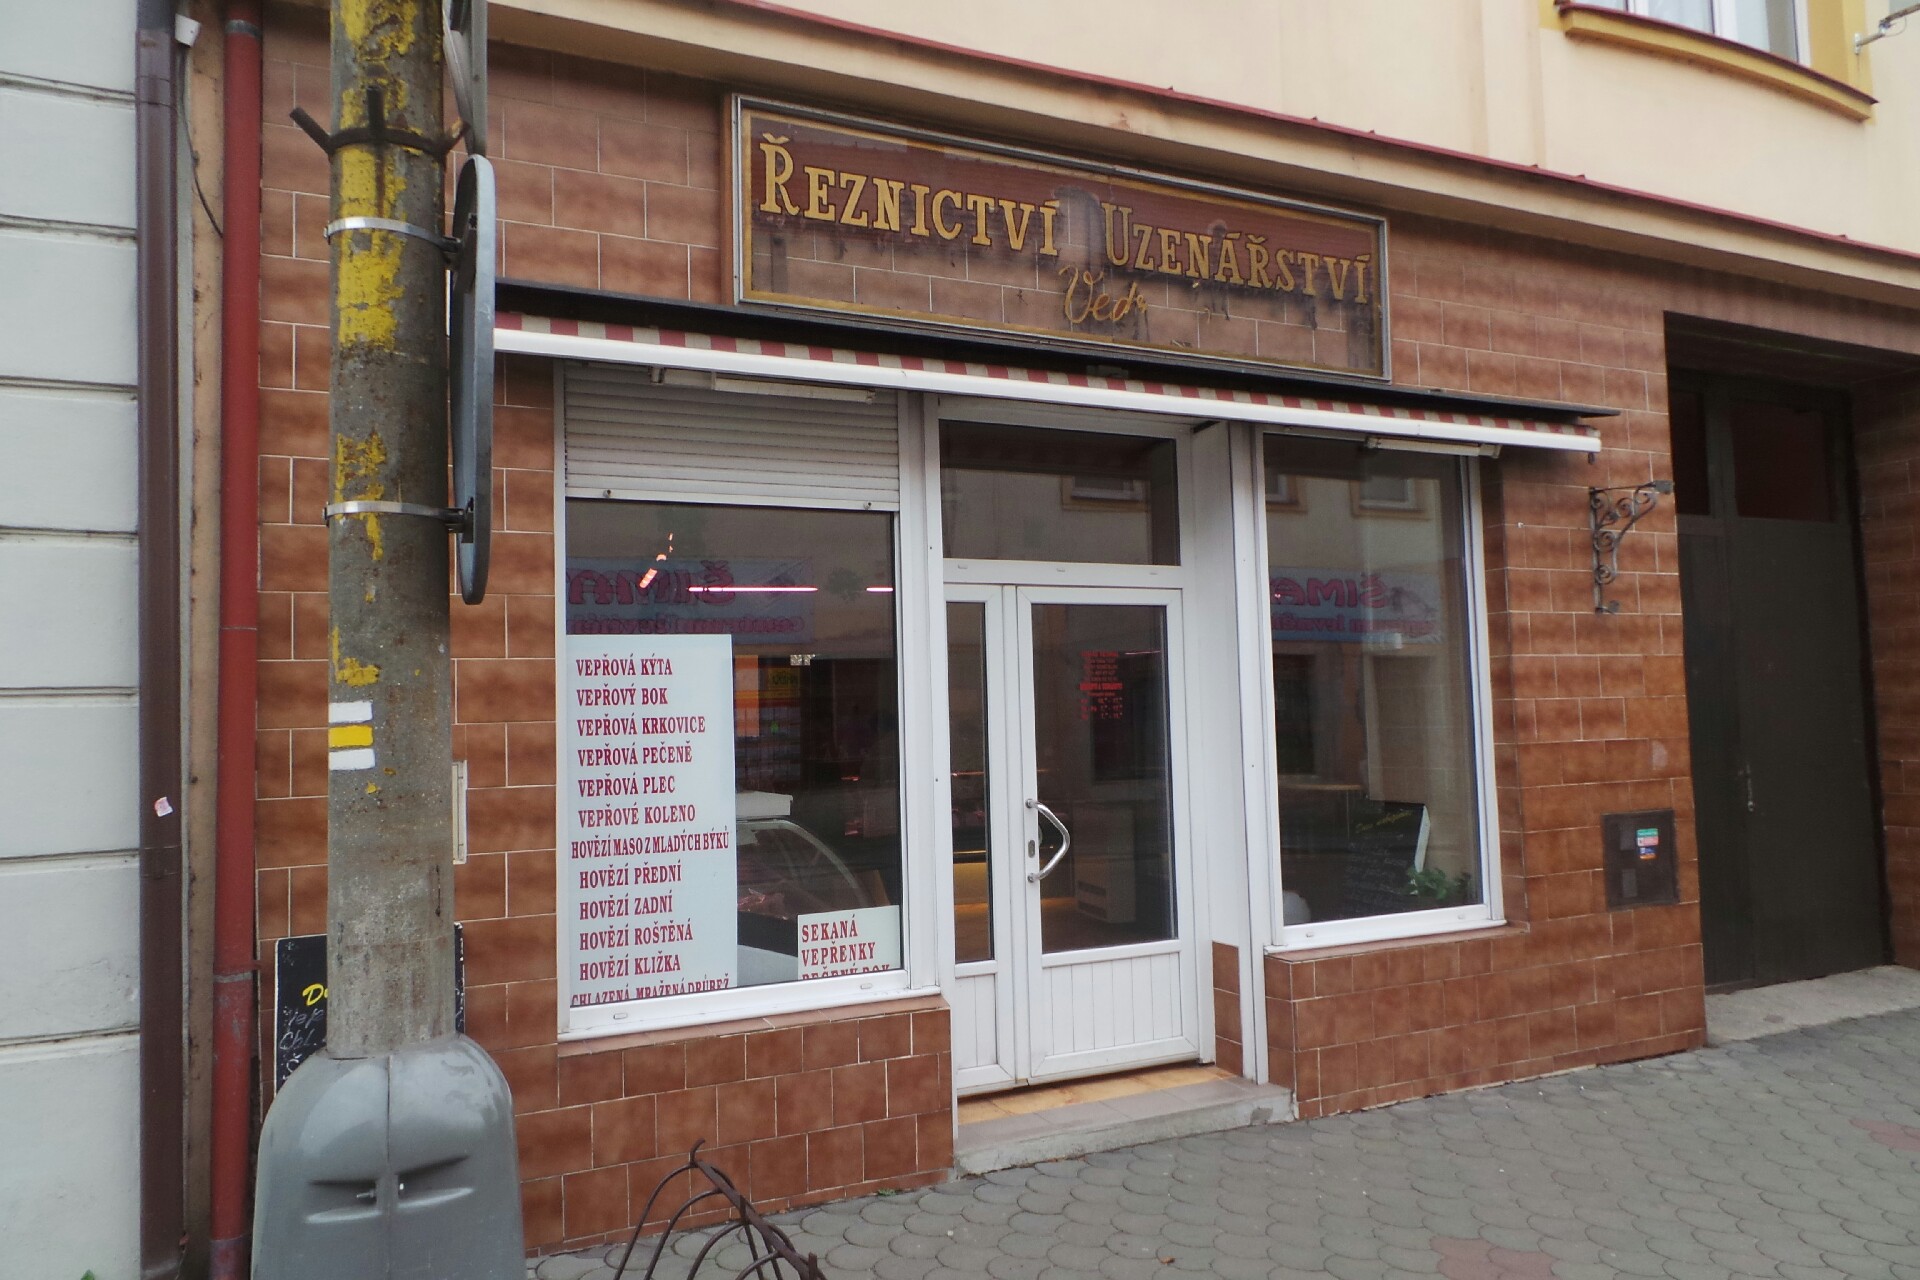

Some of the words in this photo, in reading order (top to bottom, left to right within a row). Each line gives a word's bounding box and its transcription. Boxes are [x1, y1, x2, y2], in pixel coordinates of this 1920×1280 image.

[760, 132, 1060, 256] ŘEZNICTVÍ
[1102, 202, 1370, 303] UZENÁŘSTVÍ
[576, 654, 636, 676] VEPŘOVÁ
[641, 653, 673, 676] KÝTA
[577, 684, 636, 706] VEPŘOVÝ
[641, 687, 668, 705] BOK
[577, 713, 637, 737] VEPŘOVÁ
[642, 716, 705, 735] KRKOVICE
[578, 743, 638, 767] VEPŘOVÁ
[642, 741, 692, 765] PEČENĚ
[578, 773, 638, 797] VEPŘOVÁ
[643, 776, 675, 795] PLEC
[578, 802, 639, 828] VEPŘOVÉ
[644, 804, 695, 824] KOLENO
[571, 834, 613, 859] HOVĚZÍ
[613, 838, 642, 856] MASO
[645, 838, 651, 854] Z
[653, 830, 700, 853] MLADÝCH
[702, 826, 729, 850] BÝKŮ
[580, 863, 629, 889] HOVĚZÍ
[634, 860, 682, 885] PŘEDNÍ
[580, 894, 629, 919] HOVĚZÍ
[634, 890, 673, 914] ZADNÍ
[580, 924, 629, 950] HOVĚZÍ
[634, 918, 693, 945] ROŠTĚNÁ
[802, 915, 858, 943] SEKANÁ
[580, 954, 629, 980] HOVĚZÍ
[634, 951, 681, 975] KLIŽKA
[802, 941, 876, 966] VEPŘENKY
